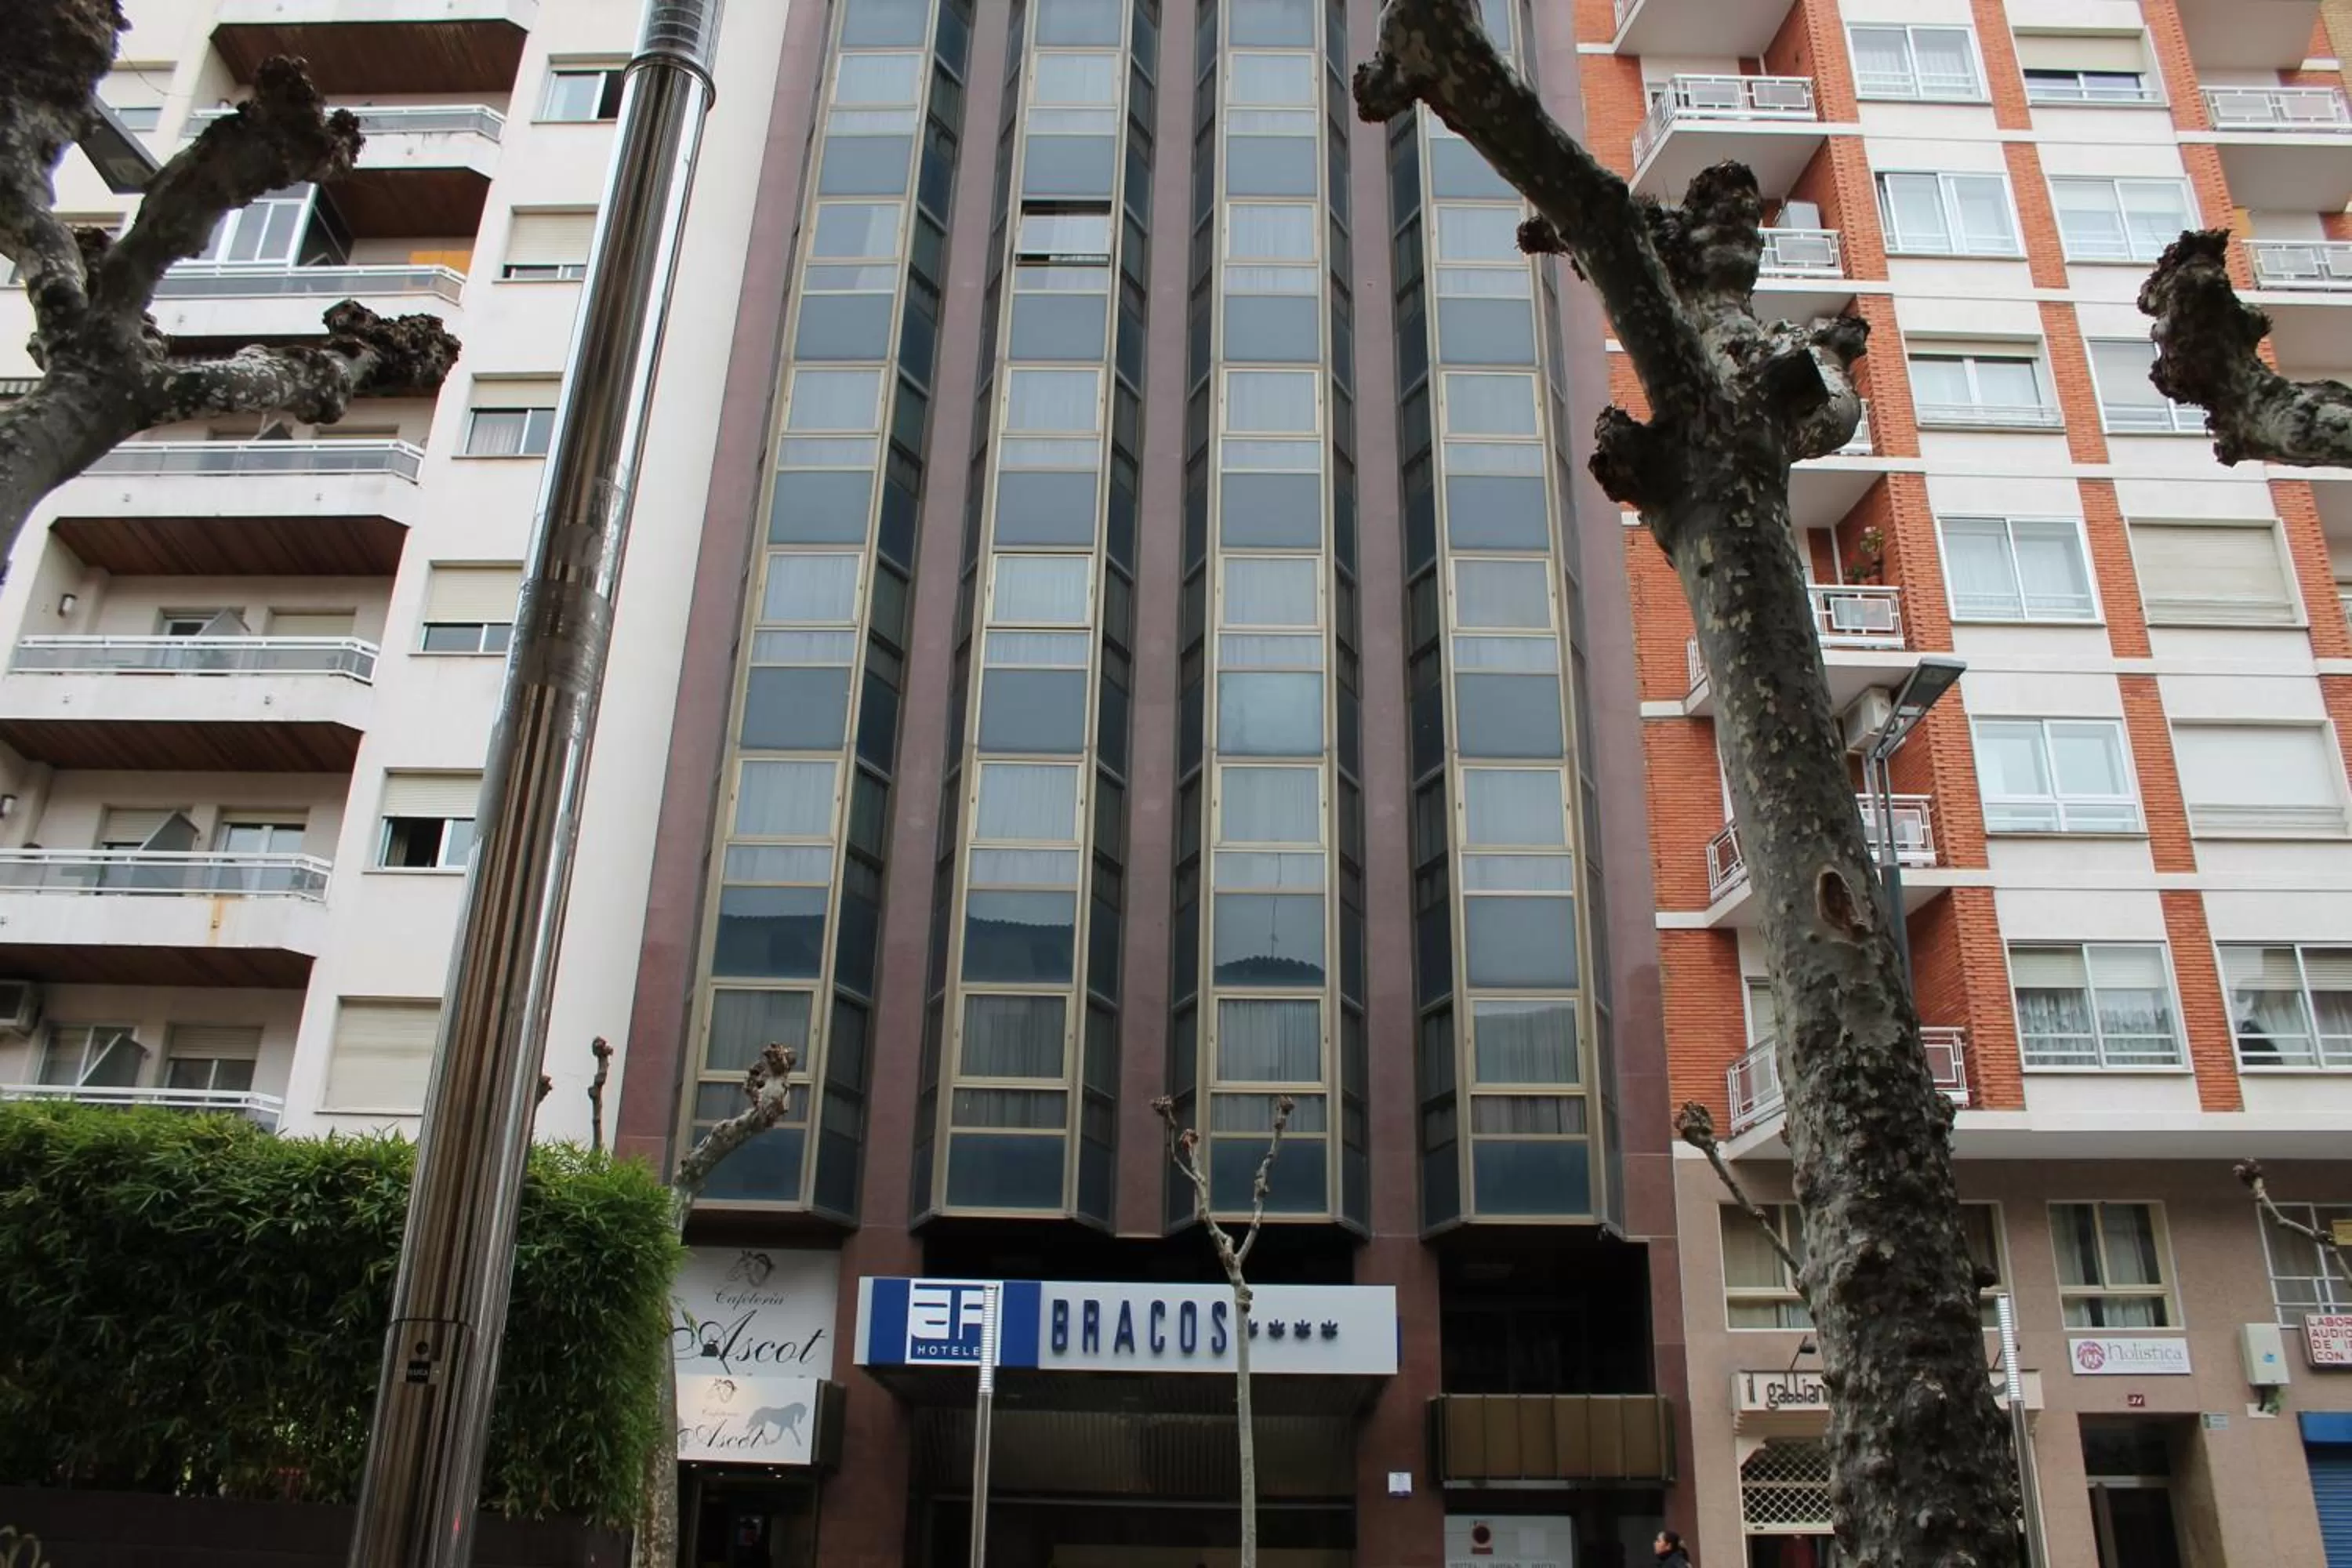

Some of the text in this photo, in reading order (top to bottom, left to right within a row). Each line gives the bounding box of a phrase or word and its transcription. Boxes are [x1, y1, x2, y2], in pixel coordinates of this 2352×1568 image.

[1051, 1298, 1229, 1355] BRACOS
[672, 1308, 826, 1374] Ascot
[916, 1345, 981, 1356] HOTELE
[2313, 1340, 2332, 1349] DE
[2315, 1351, 2346, 1361] CON
[1766, 1372, 1826, 1410] gabbian
